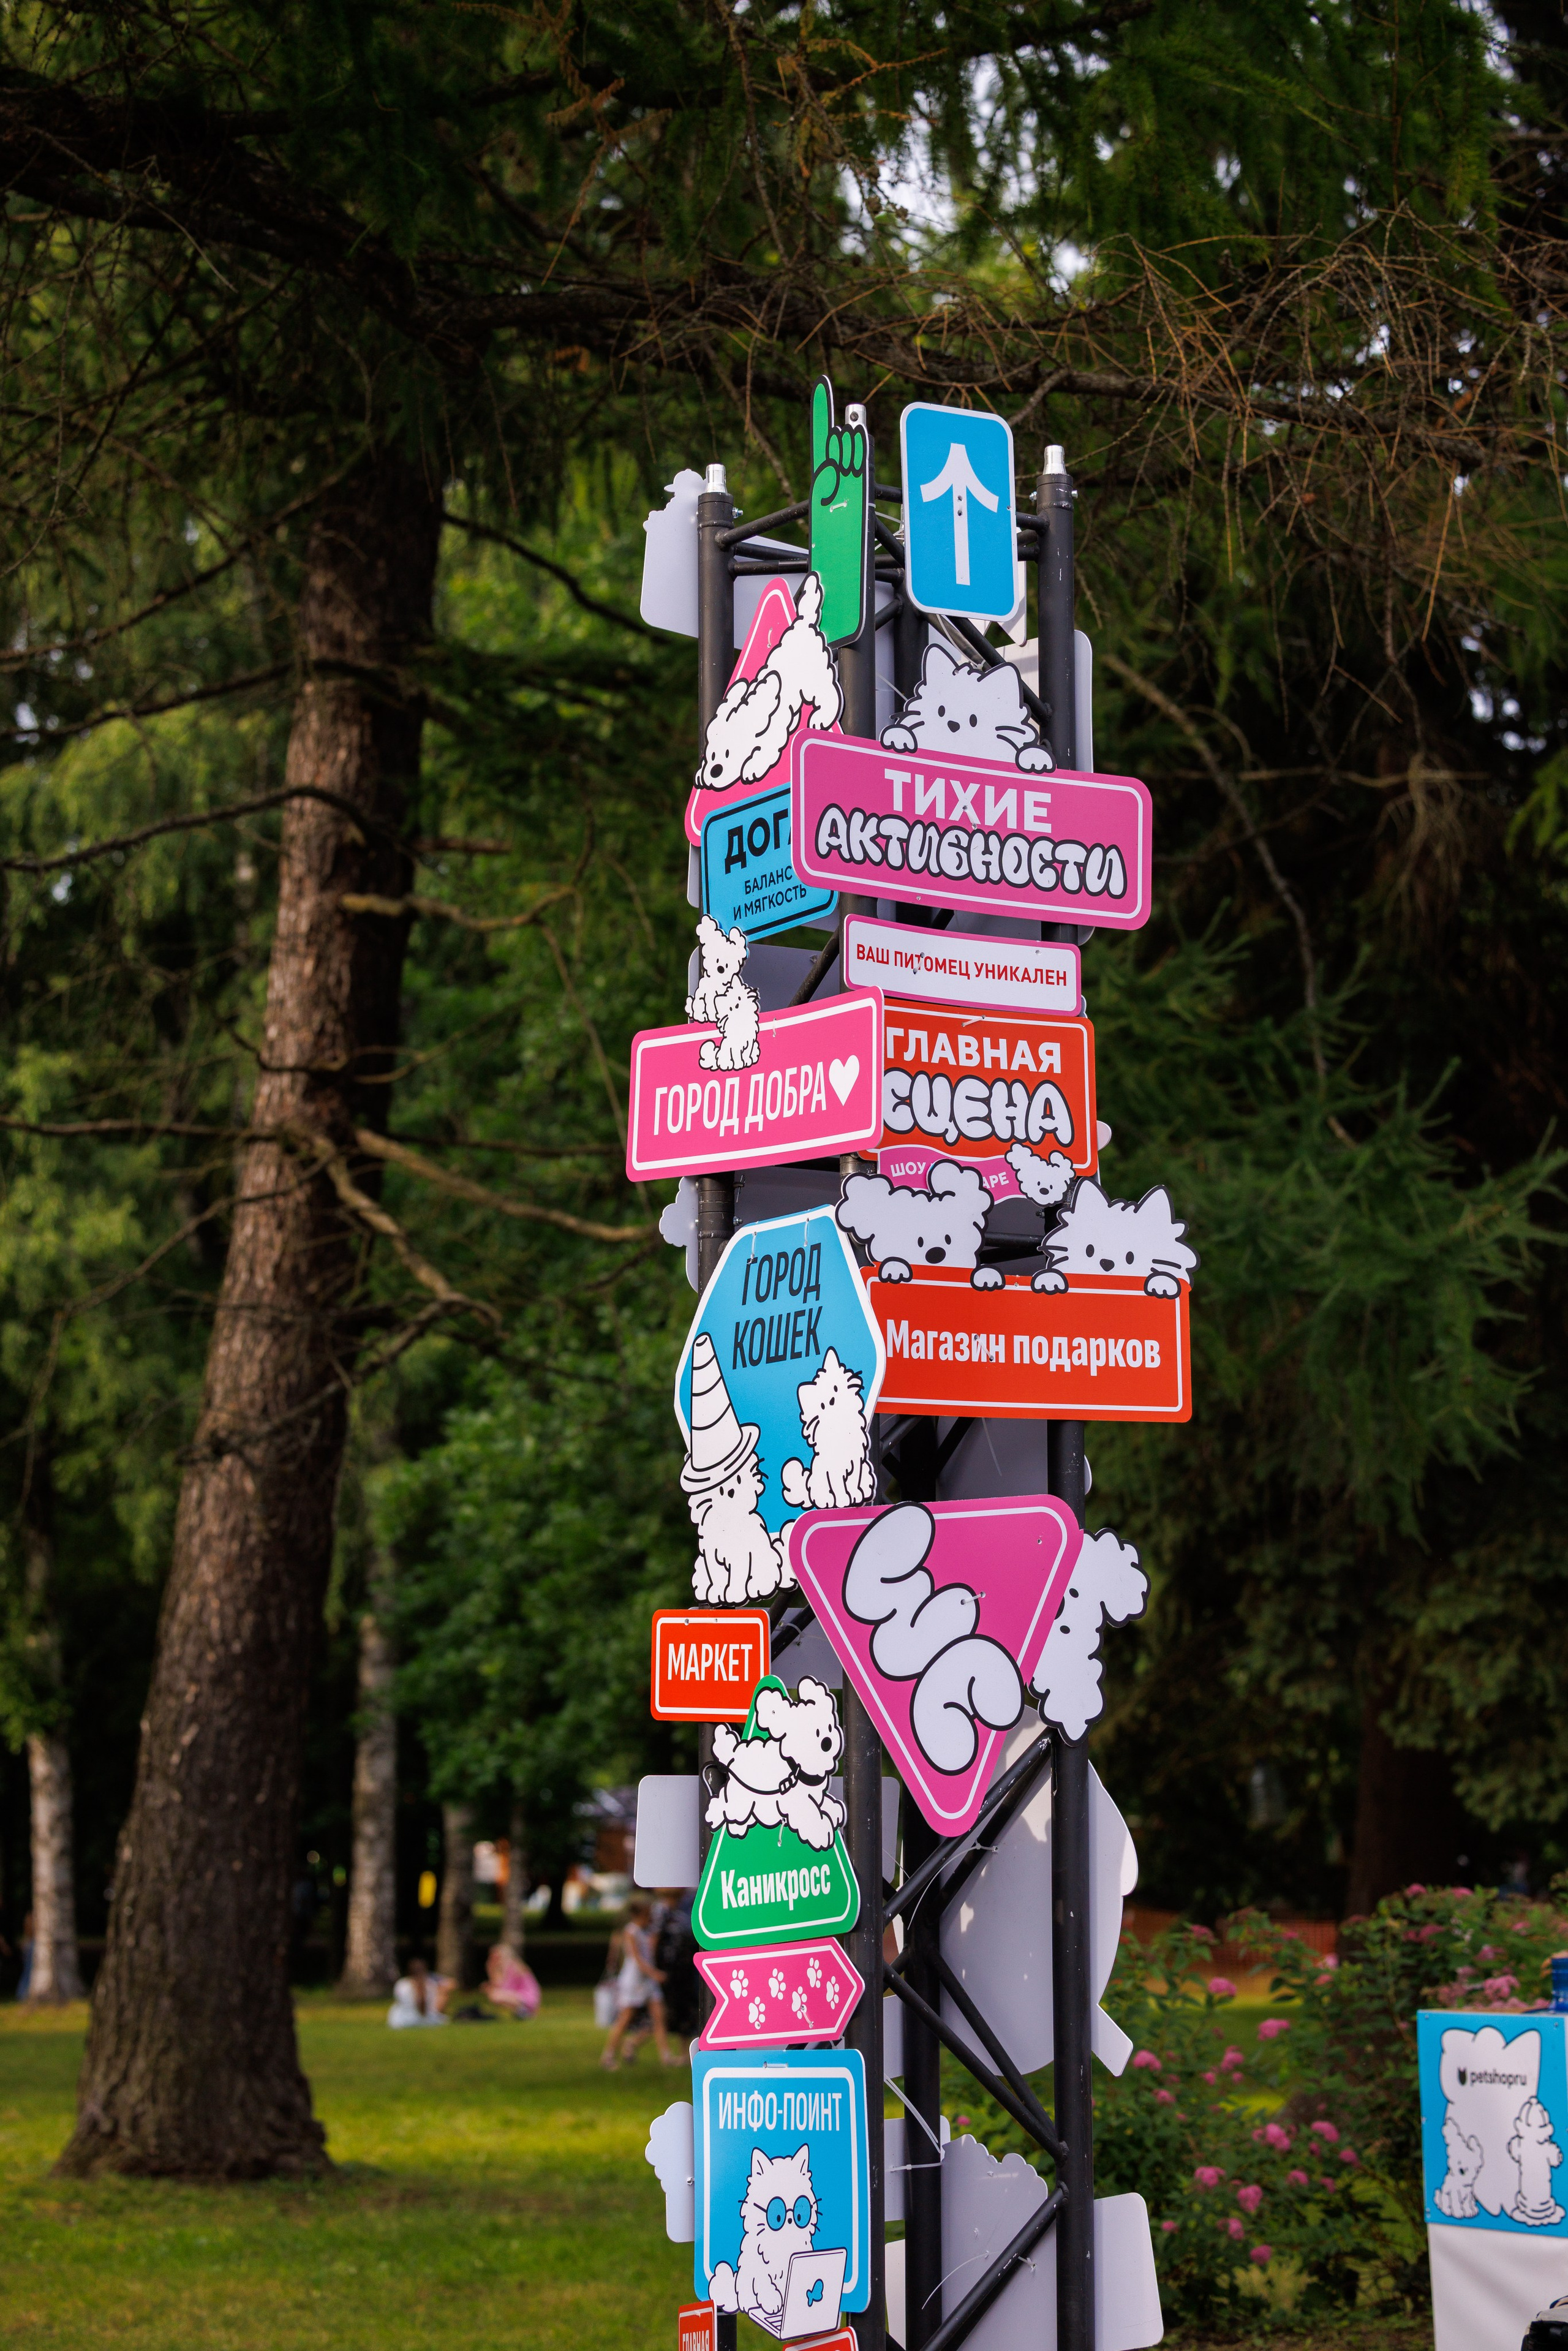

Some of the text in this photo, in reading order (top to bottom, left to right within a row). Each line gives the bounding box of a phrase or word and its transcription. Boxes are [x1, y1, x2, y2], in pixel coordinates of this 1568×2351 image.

[884, 769, 1052, 833] ТИХИЕ
[725, 808, 791, 875] ДОГ
[815, 803, 1127, 899] АКТИВНОСТИ
[733, 884, 807, 921] И МЯГКОСТЬ
[745, 866, 793, 895] БАЛАНС
[857, 943, 1067, 986] ВАШ ПИТОМЕЦ УНИКАЛЕН
[886, 1027, 1061, 1074] ГЛАВНАЯ
[654, 1063, 827, 1137] ГОРОД ДОБРА
[883, 1067, 1074, 1147] СЦЕНА
[890, 1161, 926, 1177] ШОУ
[742, 1242, 821, 1306] ГОРОД
[732, 1305, 821, 1370] КОШЕК
[886, 1319, 1161, 1376] Магазин подарков
[667, 1643, 753, 1681] МАРКЕТ
[720, 1863, 831, 1911] Каникросс
[718, 2090, 842, 2132] ИНФО-ПОИНТ
